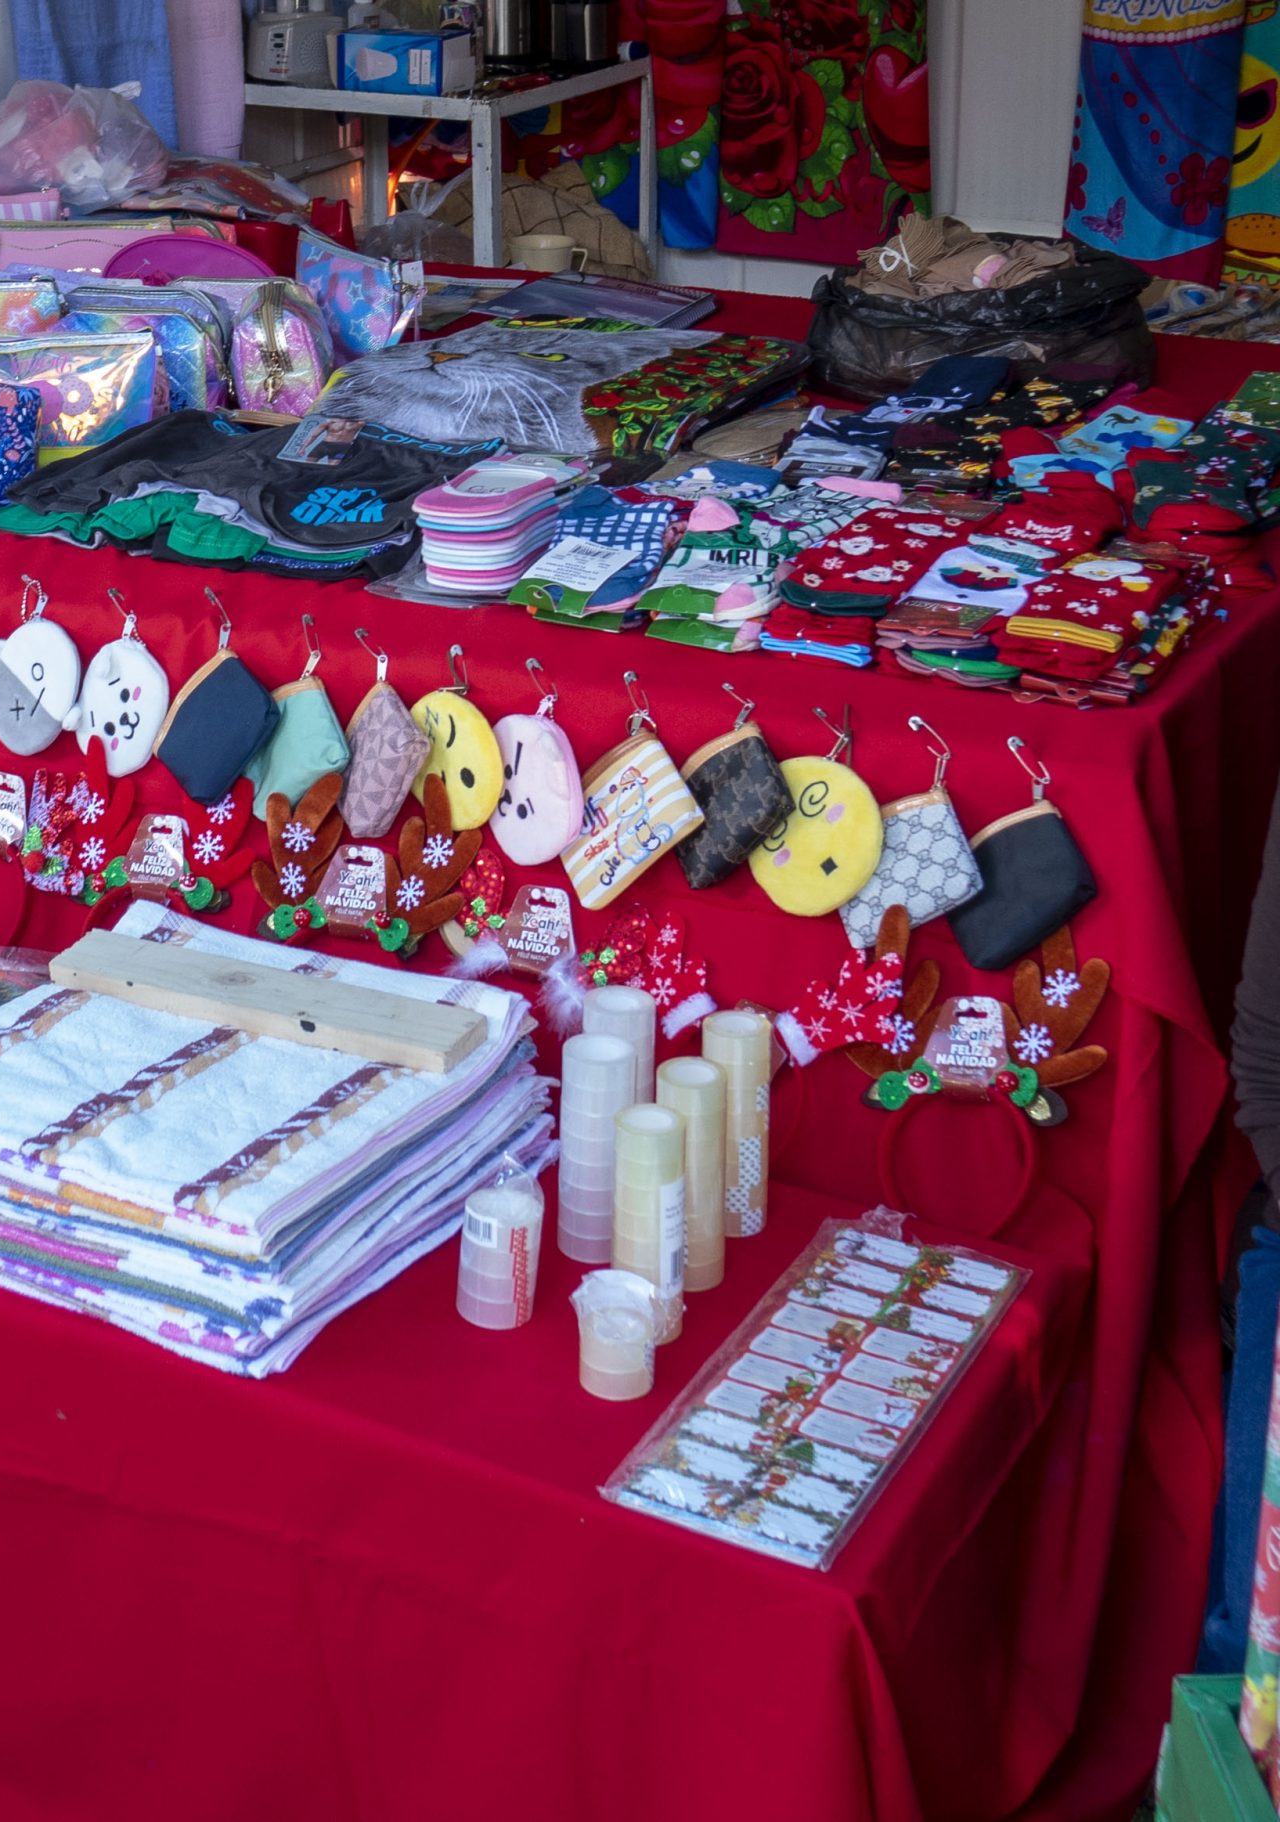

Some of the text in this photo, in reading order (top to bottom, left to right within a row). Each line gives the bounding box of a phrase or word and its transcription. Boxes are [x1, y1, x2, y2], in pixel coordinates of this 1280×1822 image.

[143, 855, 168, 867] FELIZ
[130, 862, 176, 877] NAVIDAD
[339, 869, 376, 886] Yeah!
[338, 887, 367, 900] FELIZ
[325, 895, 377, 911] NAVIDAD
[522, 911, 560, 930] Yeah!
[521, 930, 550, 944] FELIZ
[507, 938, 561, 957] NAVIDAD
[949, 1024, 993, 1041] Yeah!
[950, 1044, 983, 1057] FELIZ
[935, 1053, 997, 1068] NAVIDAD
